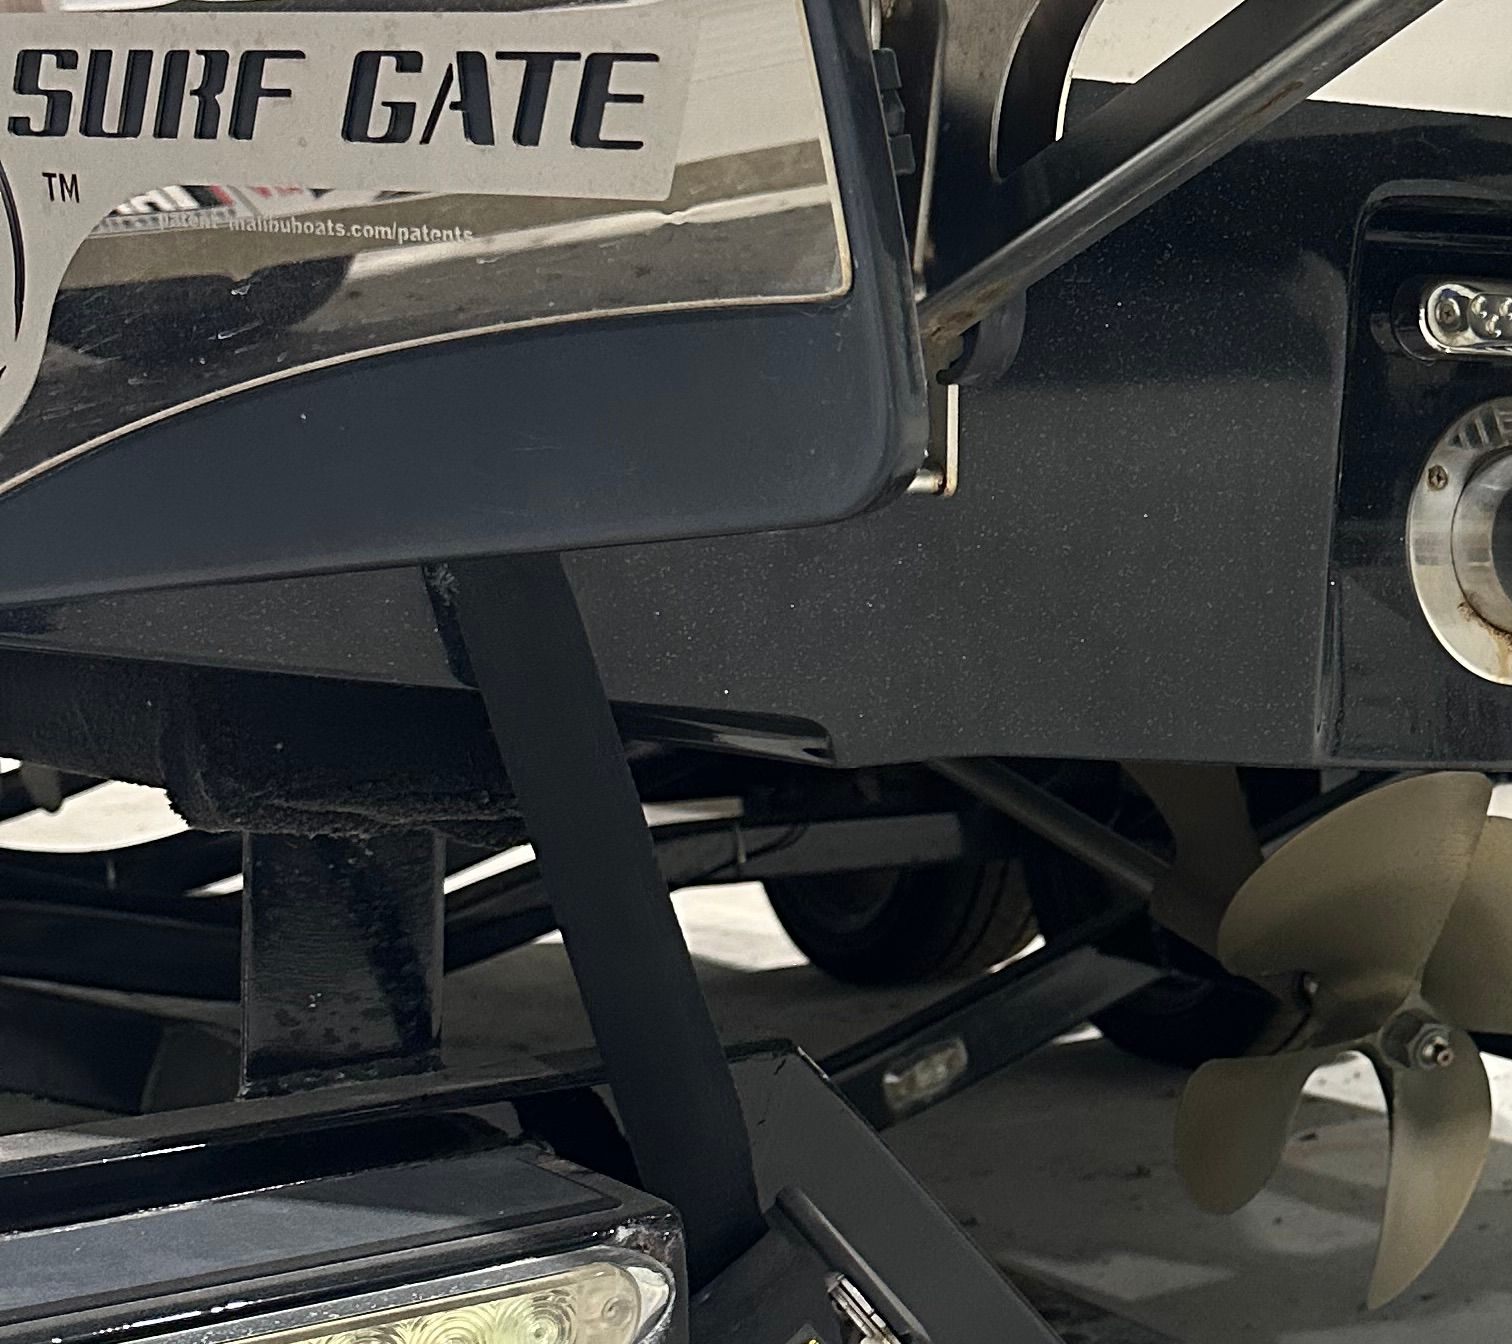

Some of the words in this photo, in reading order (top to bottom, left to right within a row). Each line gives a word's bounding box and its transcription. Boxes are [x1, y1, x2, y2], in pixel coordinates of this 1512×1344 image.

[7, 49, 306, 141] SURF
[340, 49, 660, 150] GATE
[42, 172, 81, 203] TM
